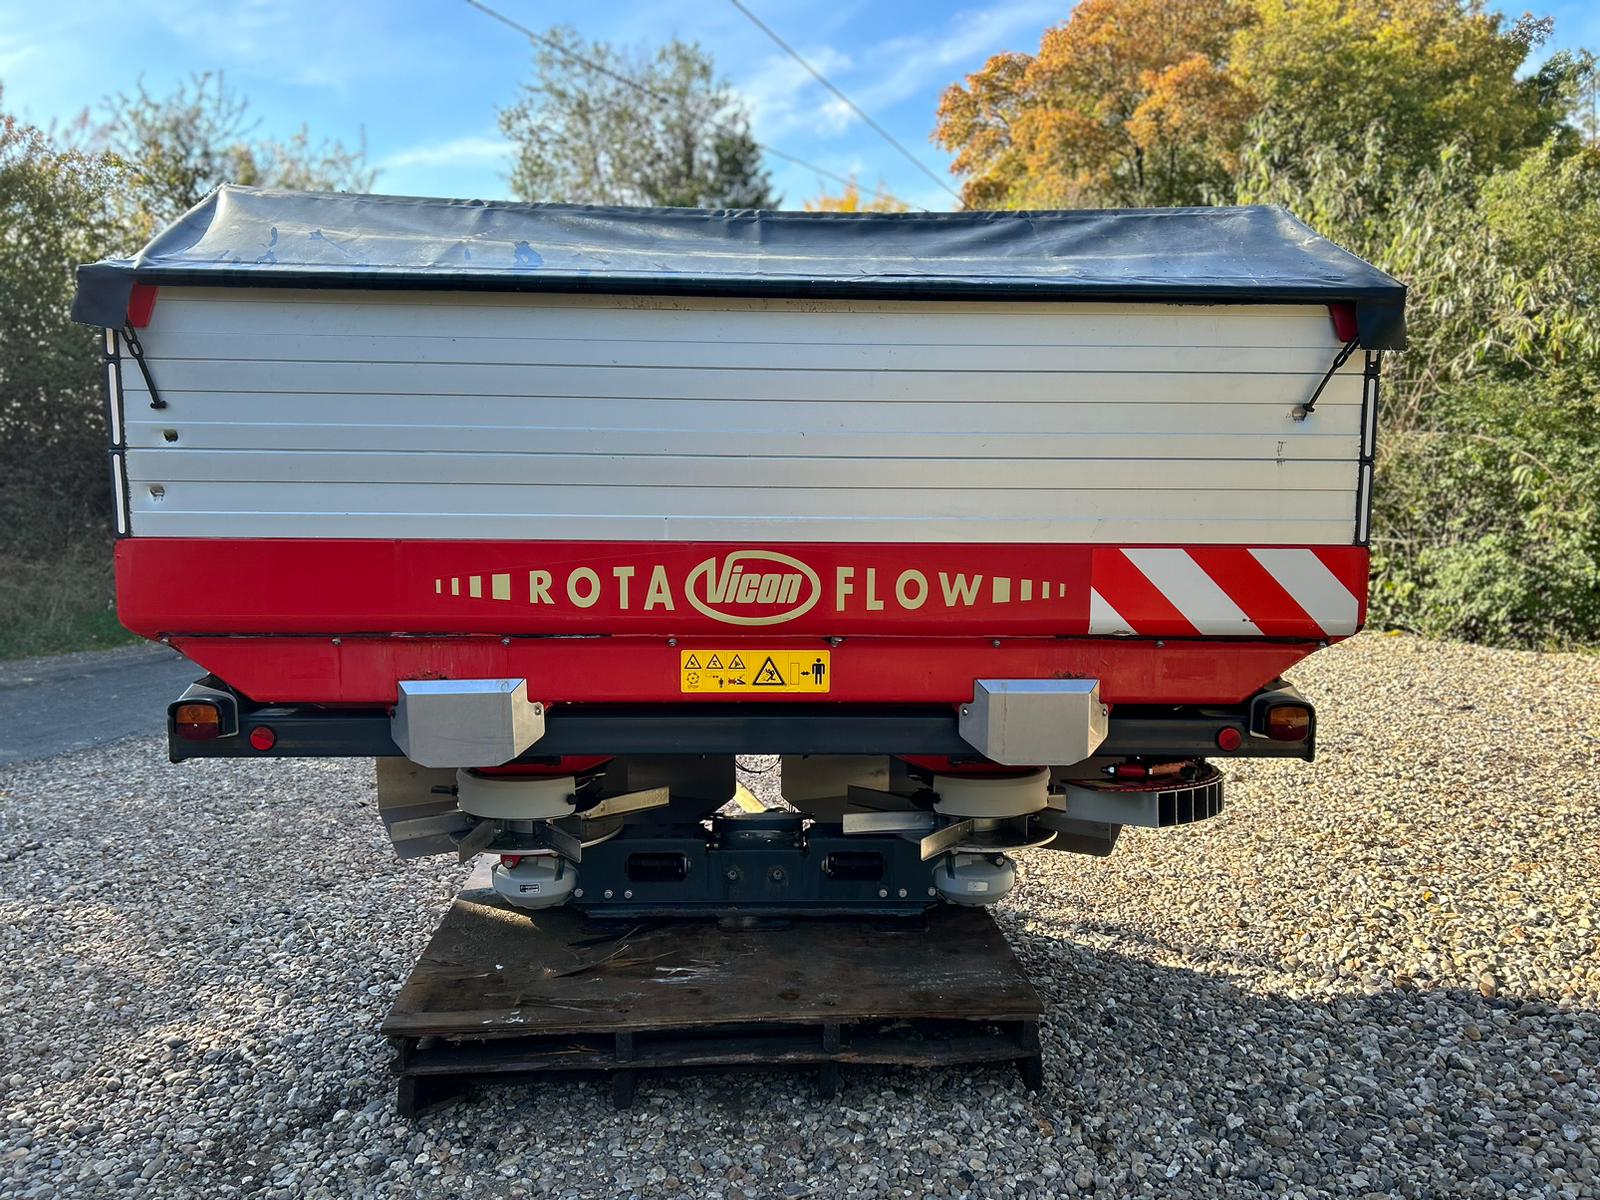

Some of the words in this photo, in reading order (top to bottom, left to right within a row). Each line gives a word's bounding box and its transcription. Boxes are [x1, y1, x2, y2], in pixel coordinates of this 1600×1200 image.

[529, 566, 675, 611] ROTA
[706, 556, 803, 604] Vicon
[836, 566, 983, 612] FLOW
